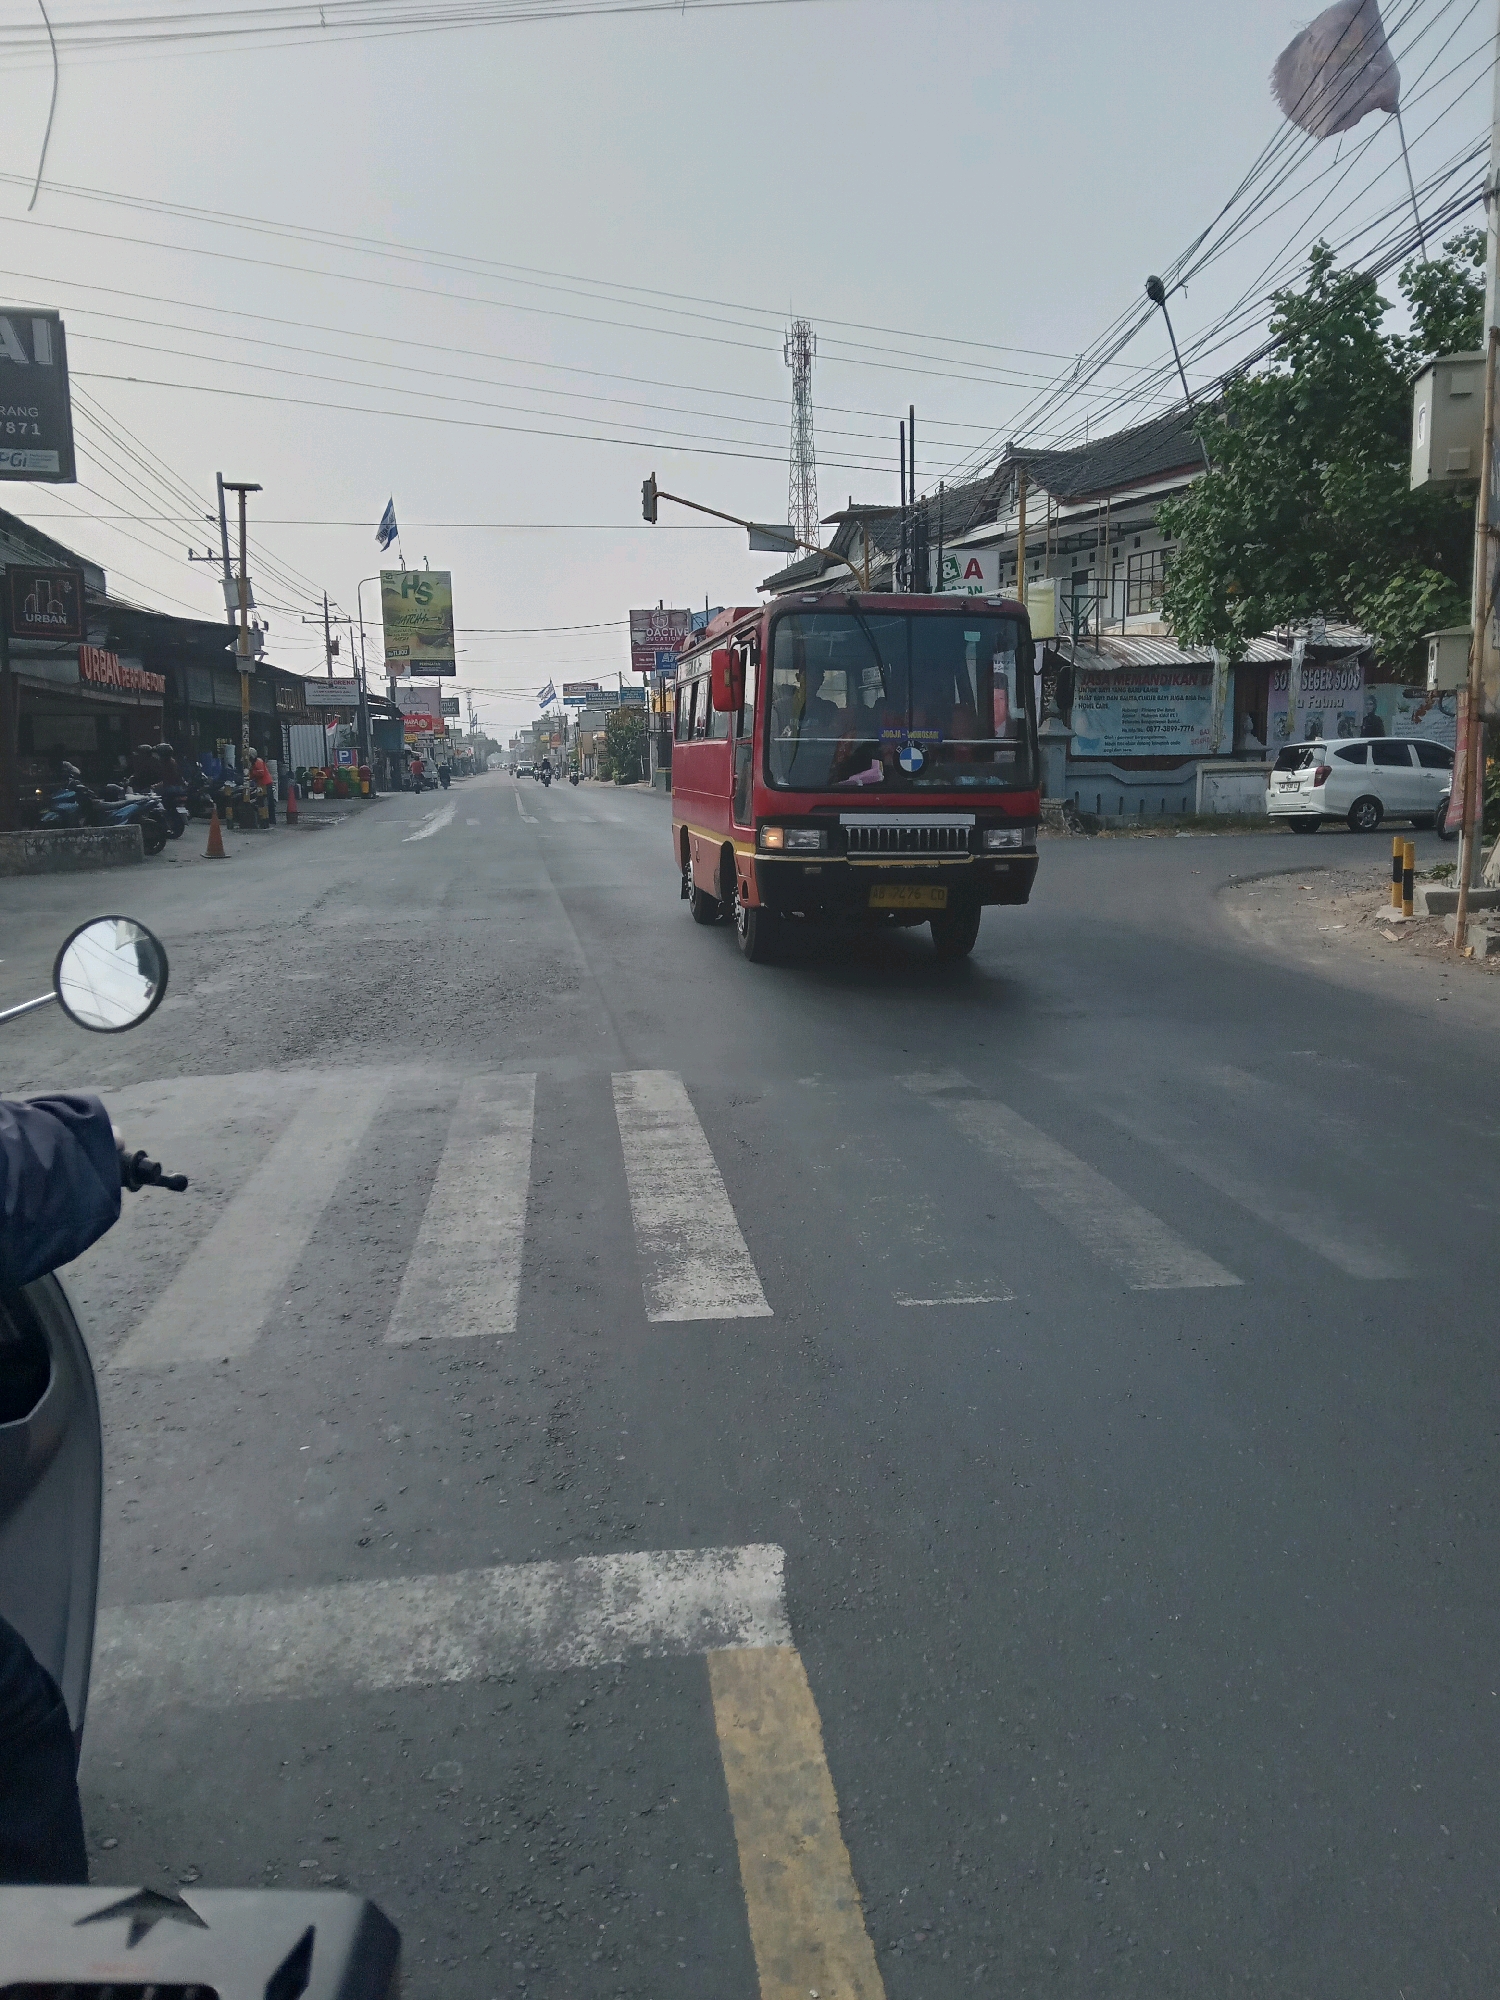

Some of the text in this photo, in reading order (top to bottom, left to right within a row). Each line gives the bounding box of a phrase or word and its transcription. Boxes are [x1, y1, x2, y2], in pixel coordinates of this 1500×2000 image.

[0, 421, 41, 435] 871
[25, 612, 67, 625] URBAN
[79, 644, 122, 687] URBAN
[1113, 673, 1199, 686] MEMANDIKAN
[1301, 668, 1335, 691] SEGER
[896, 740, 929, 754] BMW
[338, 750, 350, 762] P
